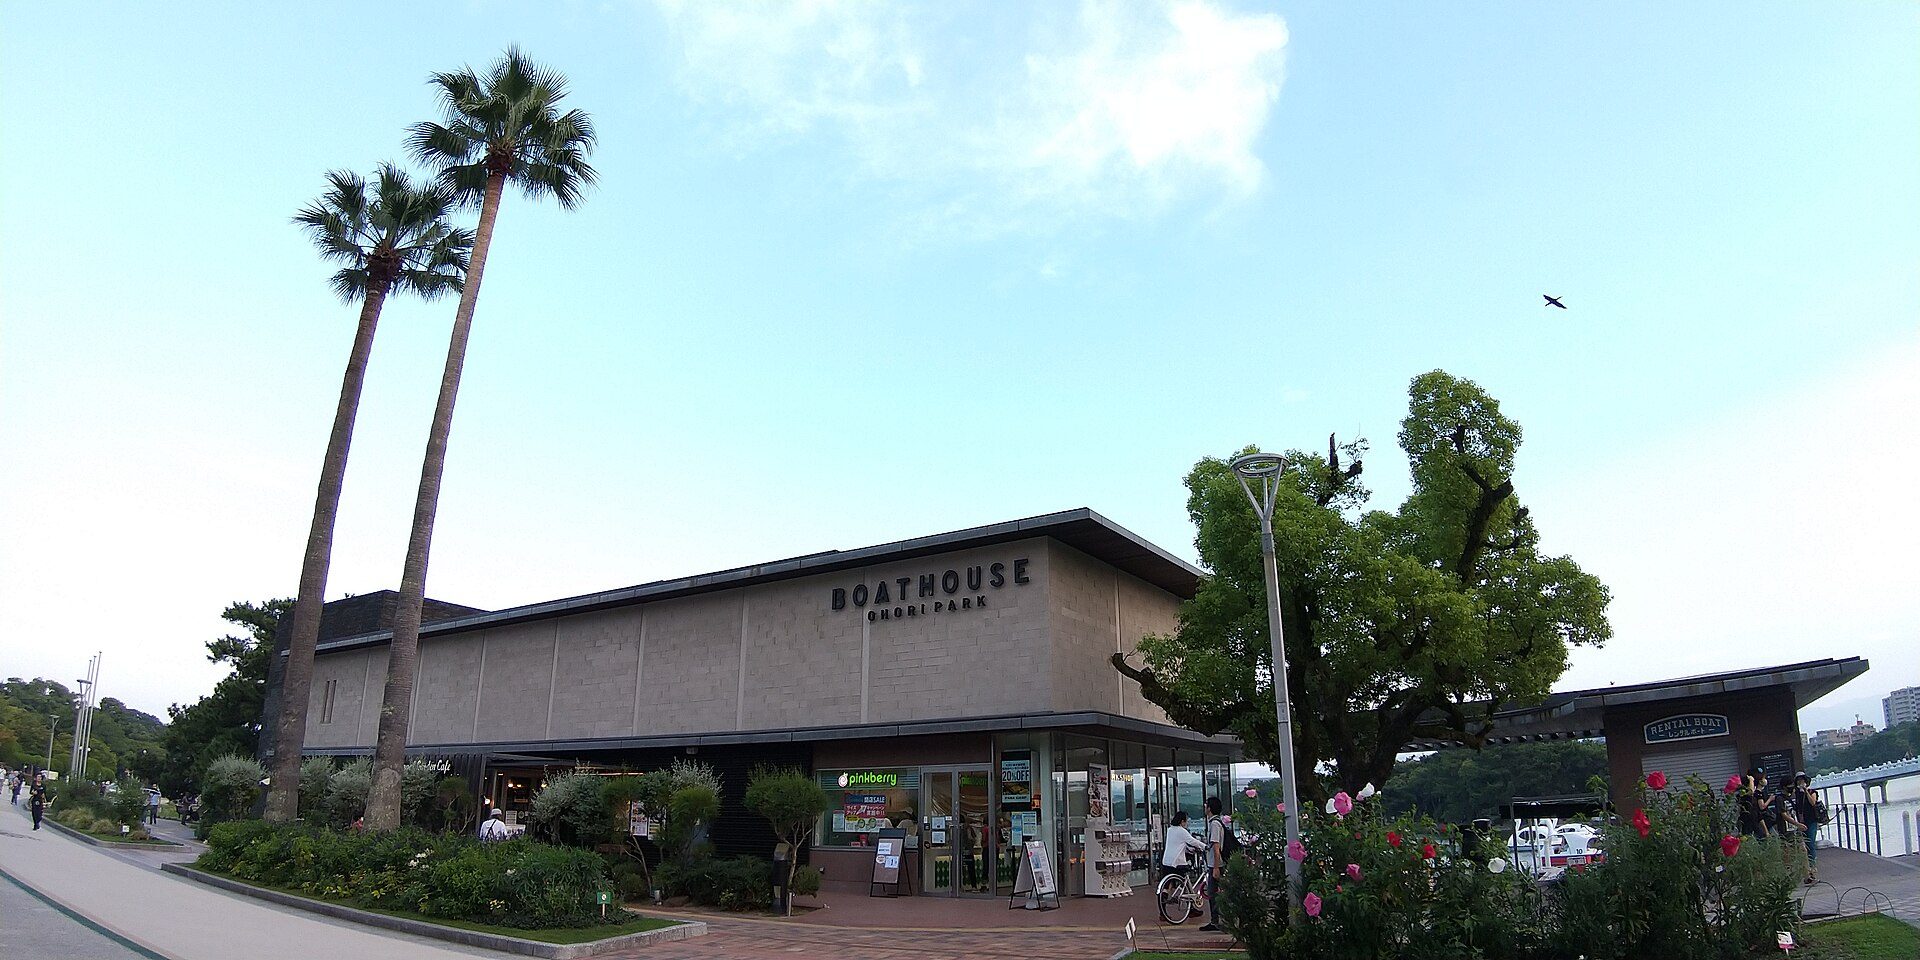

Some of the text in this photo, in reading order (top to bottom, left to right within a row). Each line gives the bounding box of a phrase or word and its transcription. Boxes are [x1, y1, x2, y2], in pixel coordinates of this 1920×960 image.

[831, 558, 1030, 610] BOATHOUSE
[867, 595, 986, 622] OHORI PARK
[1650, 717, 1721, 735] RENTAL BOAT
[1668, 727, 1705, 738] レンタルボート
[849, 772, 897, 786] pinkberry
